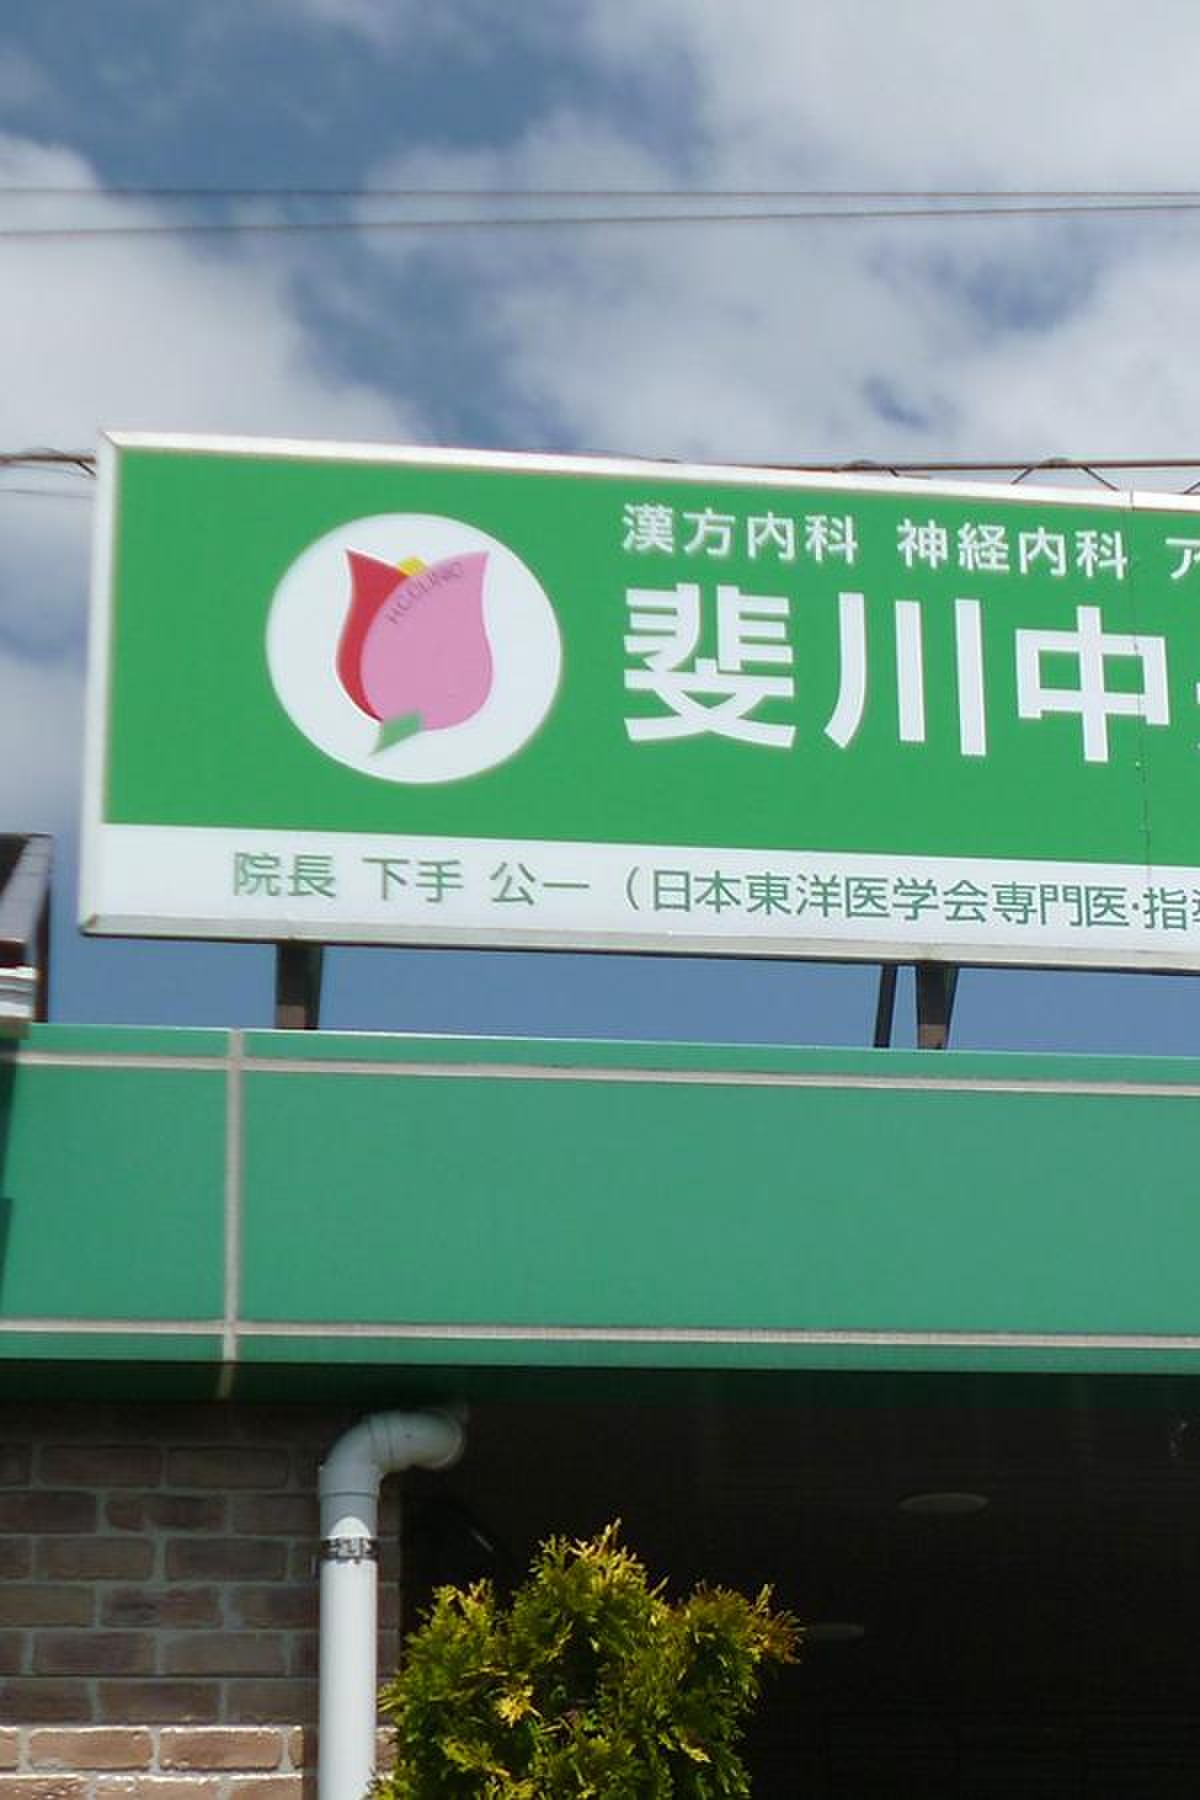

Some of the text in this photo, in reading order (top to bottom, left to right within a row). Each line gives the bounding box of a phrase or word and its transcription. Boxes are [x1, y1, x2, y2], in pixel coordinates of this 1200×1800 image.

[623, 503, 859, 564] 漢方内科
[897, 518, 1128, 580] 神経内科
[233, 852, 337, 899] 院長
[362, 857, 465, 904] 下手
[489, 861, 591, 907] 公一
